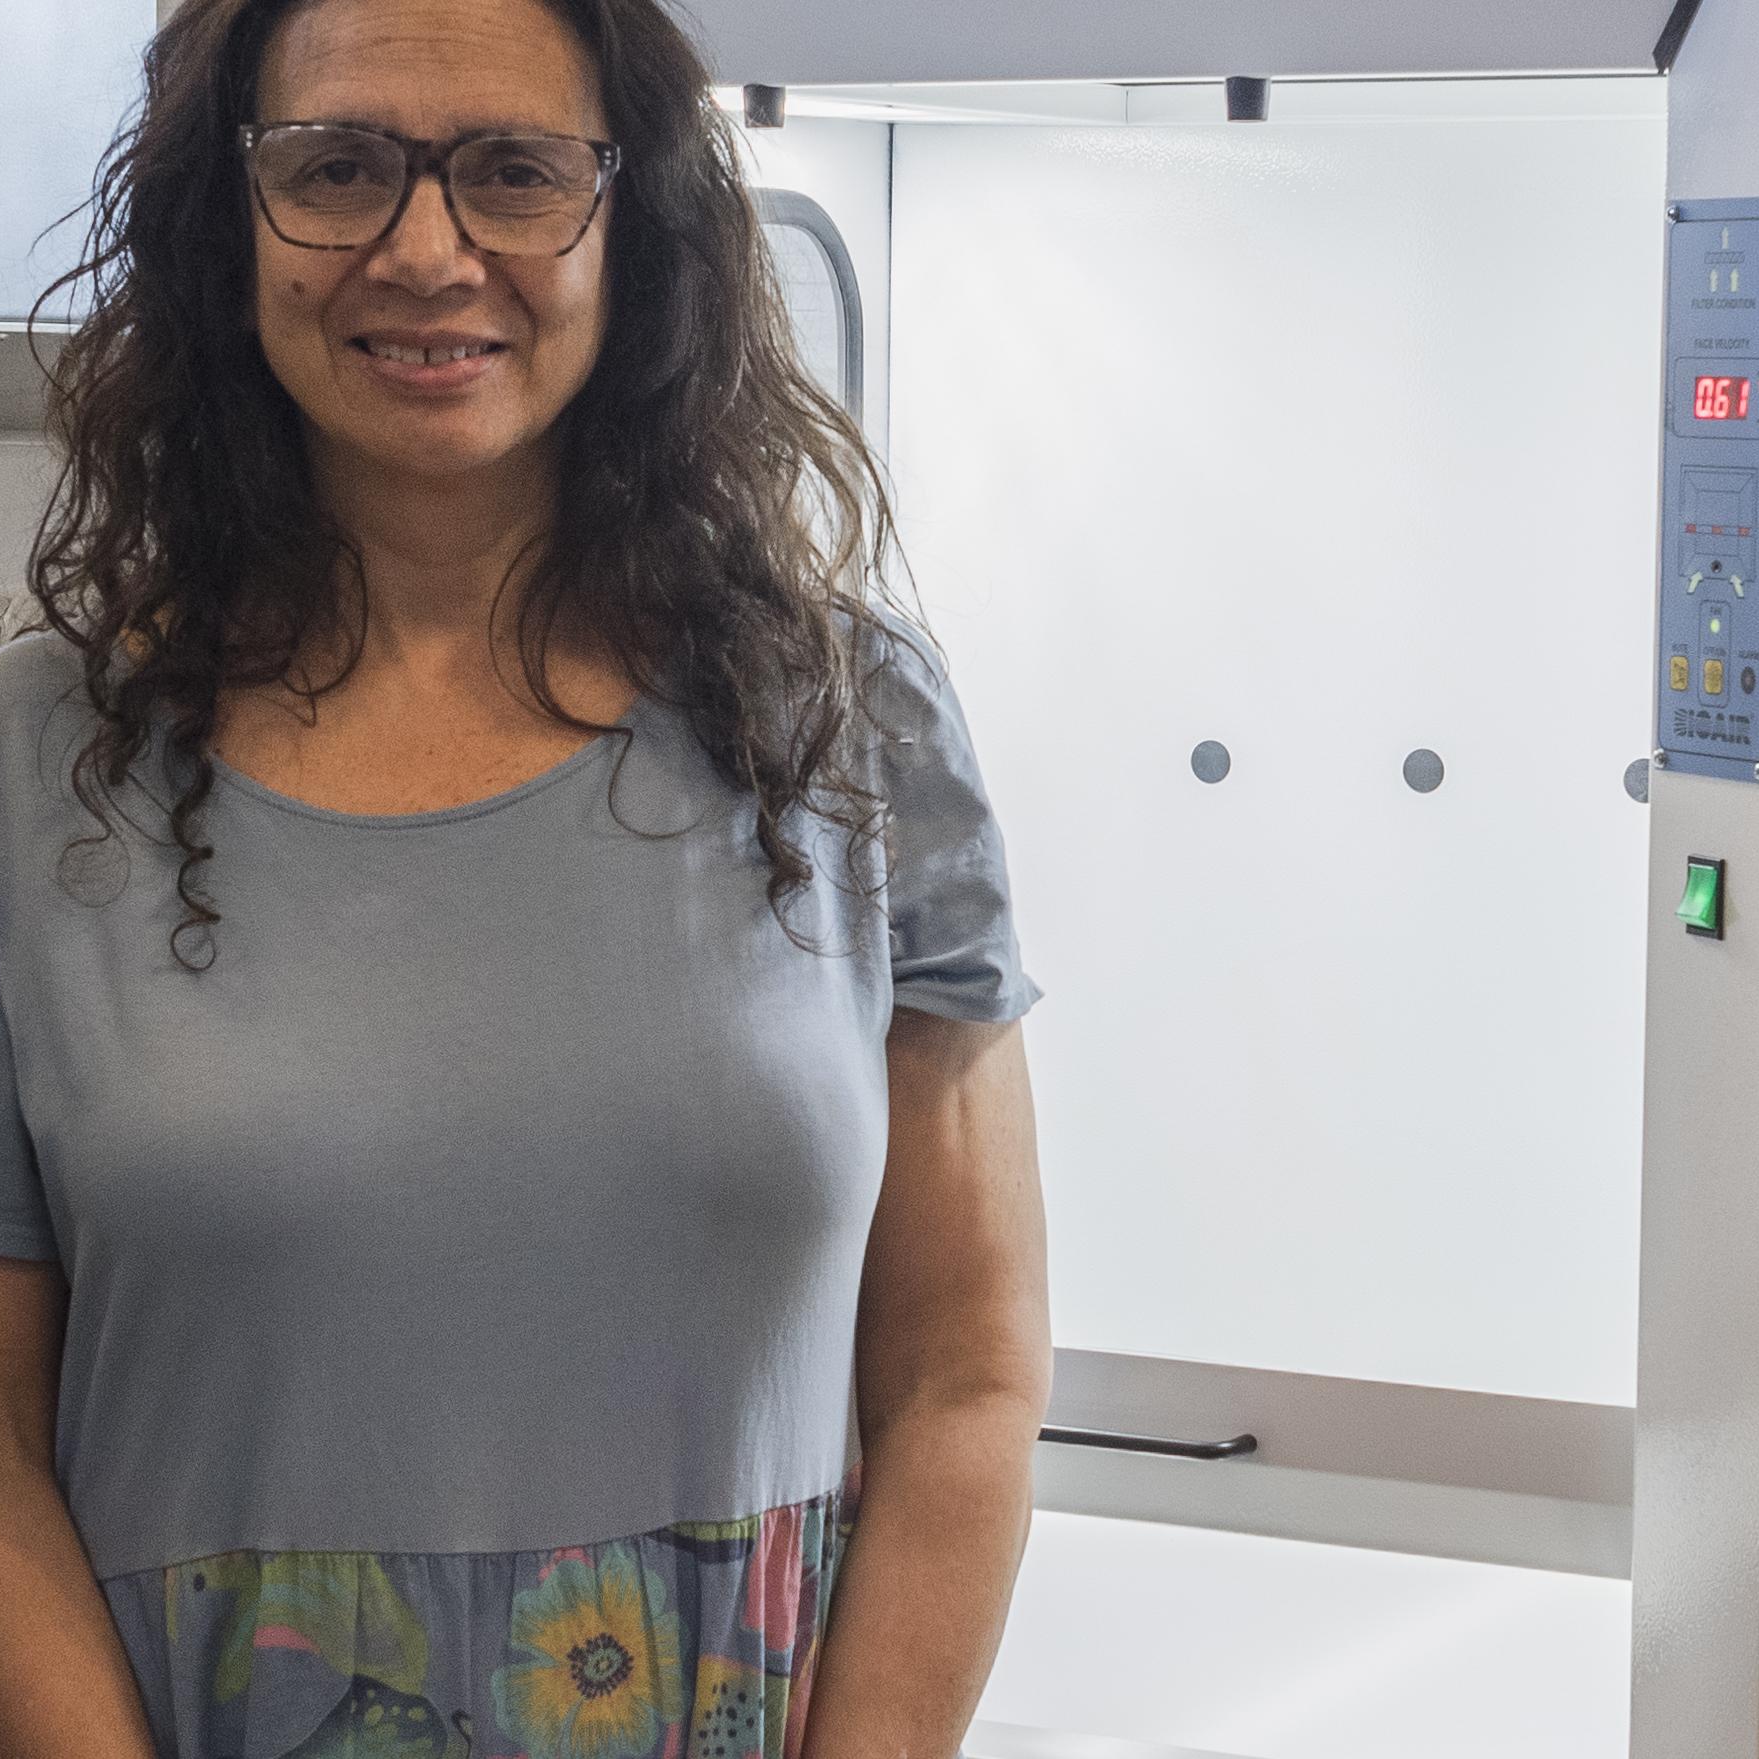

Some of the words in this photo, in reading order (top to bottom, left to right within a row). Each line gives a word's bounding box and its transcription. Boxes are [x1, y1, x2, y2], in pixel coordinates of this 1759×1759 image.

[1692, 298, 1714, 309] FILTER
[1716, 297, 1756, 310] CONDITION
[1695, 339, 1713, 349] FACE
[1715, 339, 1750, 350] VELOCITY
